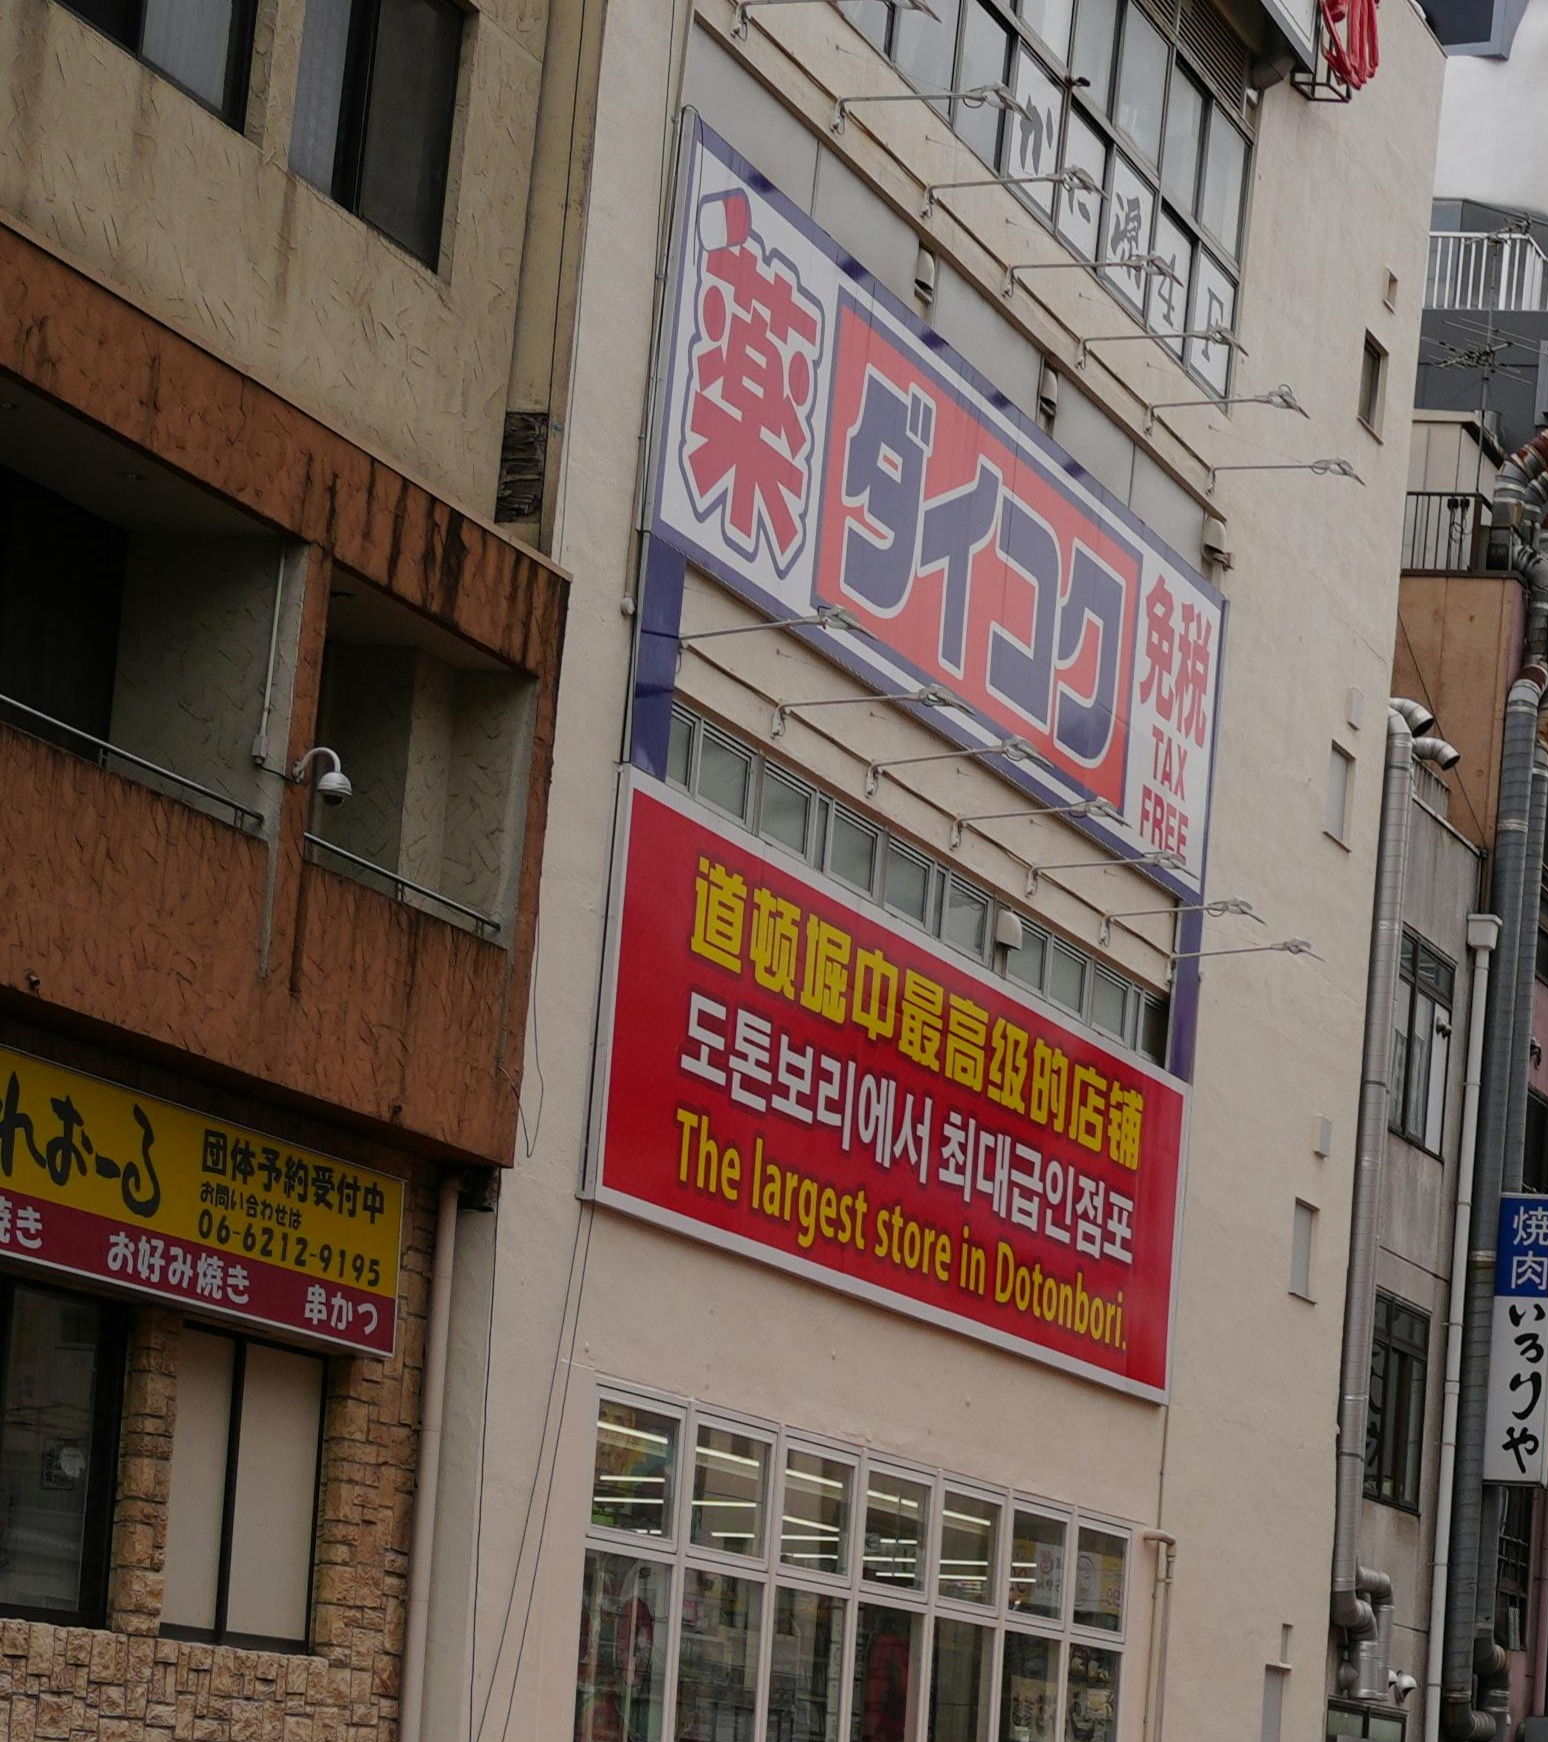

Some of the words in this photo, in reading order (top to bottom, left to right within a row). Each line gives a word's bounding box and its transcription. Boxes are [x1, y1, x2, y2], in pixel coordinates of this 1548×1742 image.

[687, 243, 819, 557] 薬
[843, 365, 1126, 768] ダイコク
[1139, 573, 1211, 750] 免税
[1139, 787, 1190, 857] FREE
[1150, 723, 1189, 803] TAX
[200, 1128, 385, 1225] 団体予約受付中
[680, 992, 934, 1184] 도톤보리에서
[938, 1110, 1135, 1264] 최대급인점포
[198, 1209, 382, 1288] 06-6212-9195
[200, 1181, 302, 1231] お問い合わせは
[676, 1108, 739, 1200] The
[752, 1137, 868, 1249] largest
[874, 1201, 951, 1282] store
[961, 1227, 986, 1296] in
[995, 1241, 1128, 1351] Dotonbori.
[107, 1231, 251, 1306] お好み焼き
[304, 1284, 379, 1336] 串かつ
[1500, 1302, 1546, 1475] いろりや
